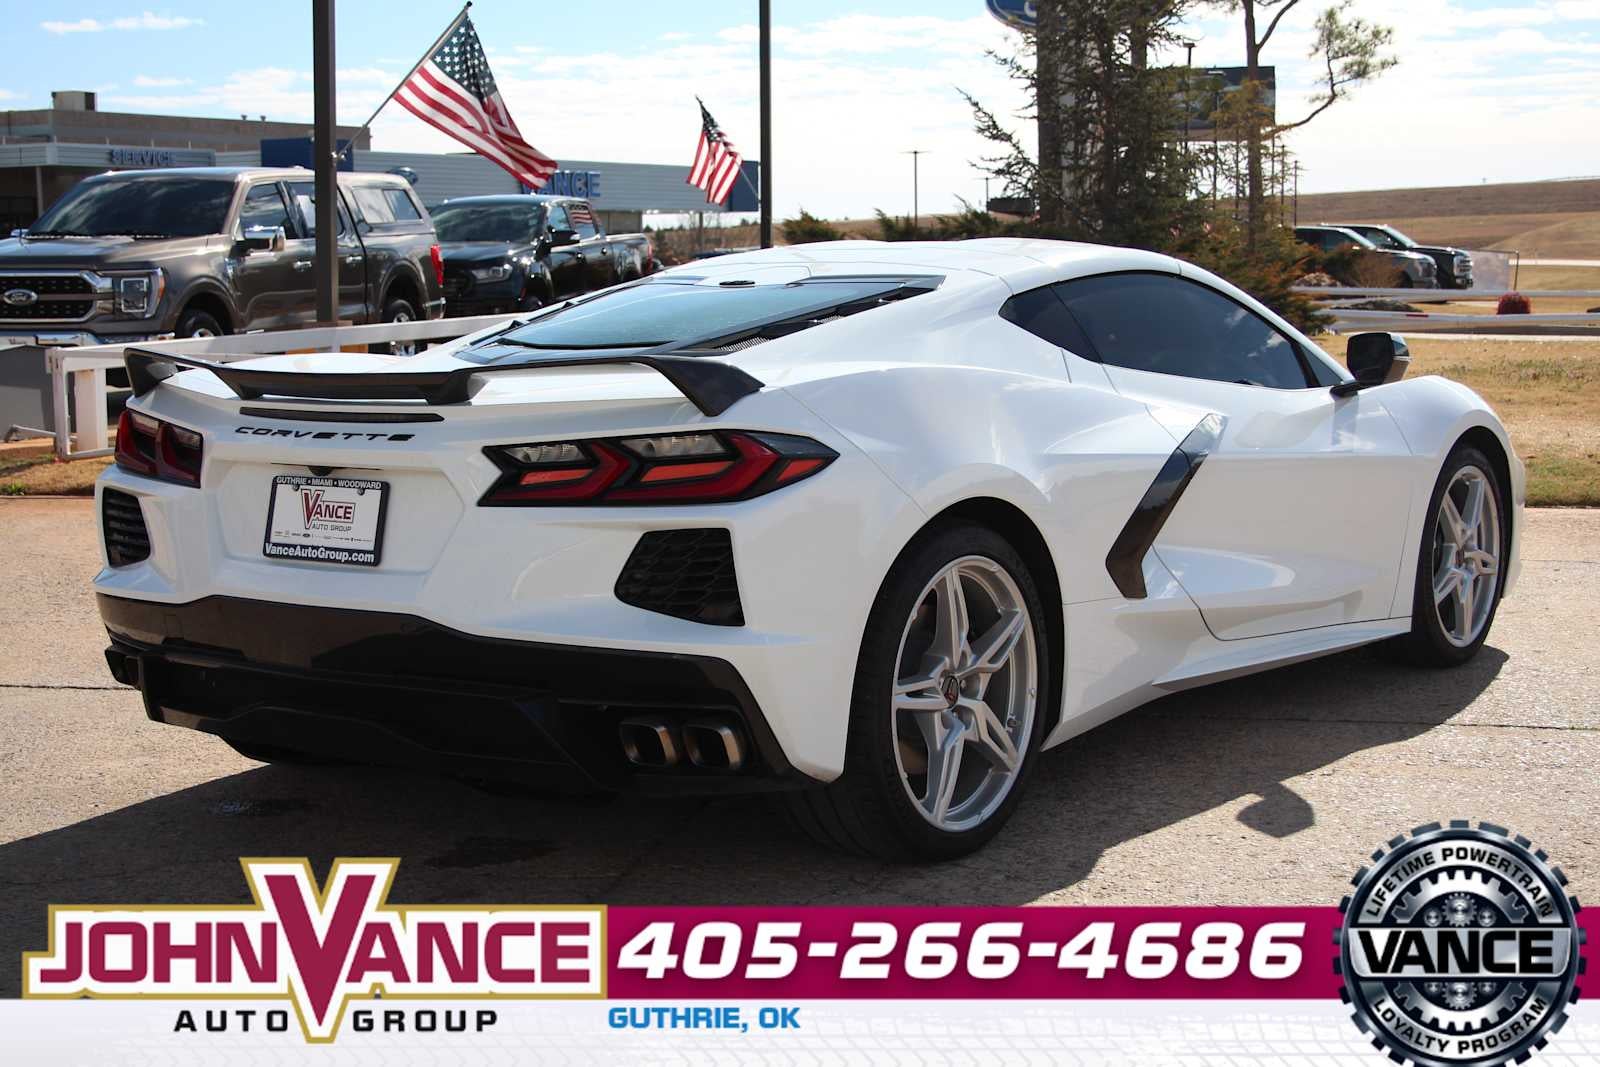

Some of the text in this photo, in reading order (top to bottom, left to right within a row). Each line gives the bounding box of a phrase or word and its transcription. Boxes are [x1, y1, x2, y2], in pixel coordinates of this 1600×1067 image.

[110, 149, 177, 166] SERVICE
[520, 169, 602, 198] ANCE
[235, 426, 415, 441] CORVETTE
[276, 475, 381, 490] GUTHRIE MIAMI WOODWARD
[302, 489, 355, 530] VANCE
[311, 522, 352, 533] AUTO GROUP
[265, 543, 375, 562] VanceAutoGroup.com
